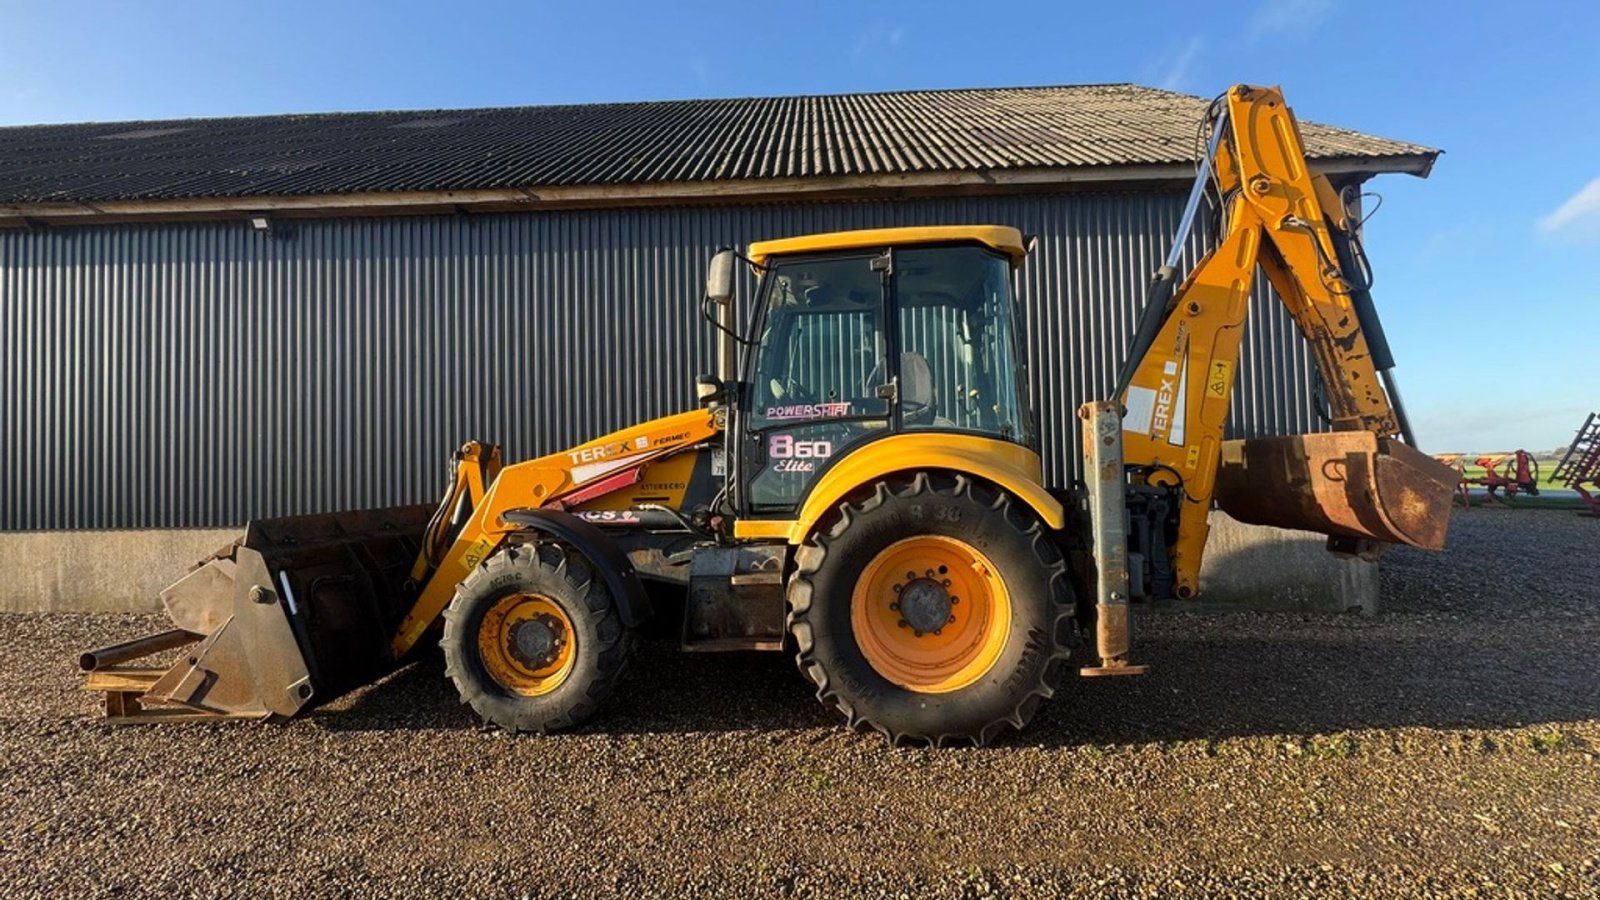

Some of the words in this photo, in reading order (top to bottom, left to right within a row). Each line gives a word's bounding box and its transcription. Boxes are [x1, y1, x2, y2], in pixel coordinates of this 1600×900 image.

[766, 402, 851, 419] POWERSHIFT
[1151, 379, 1175, 441] TEREX
[769, 435, 831, 458] 860
[773, 459, 813, 472] Elite
